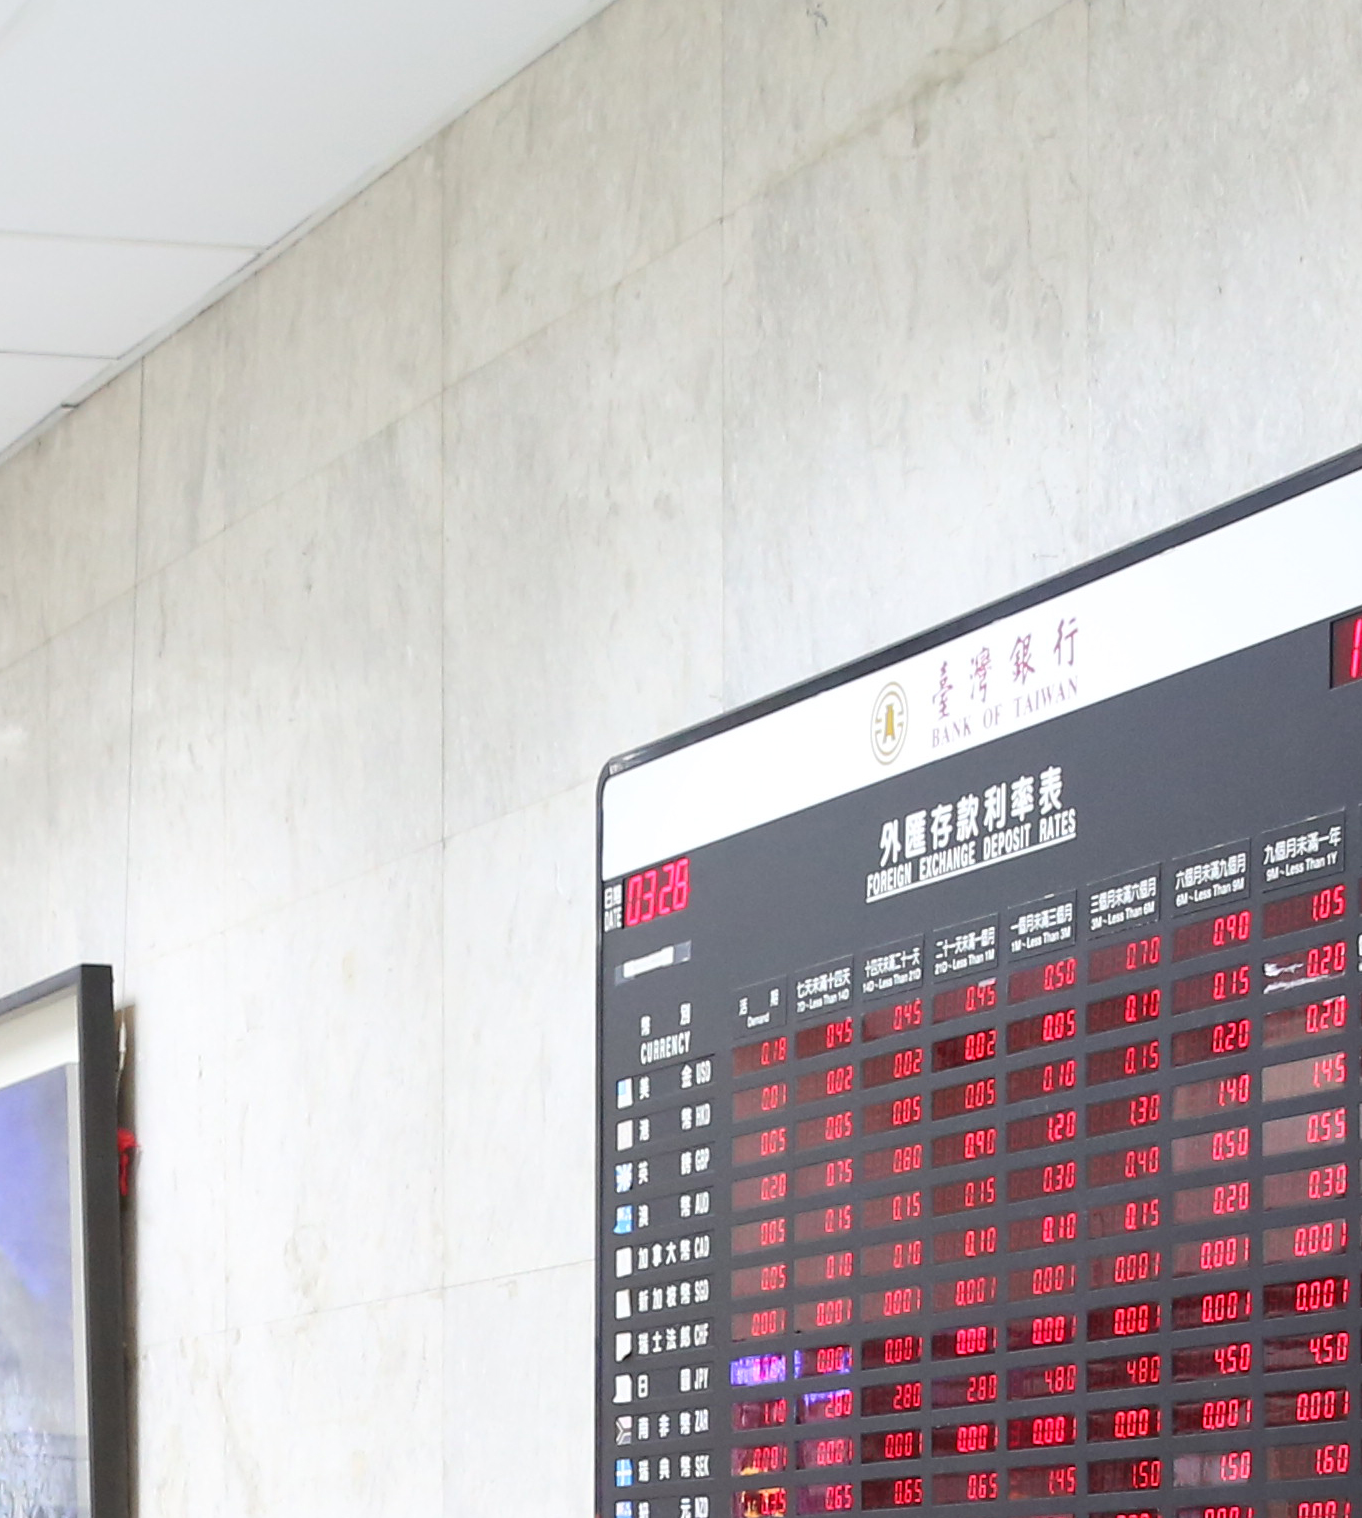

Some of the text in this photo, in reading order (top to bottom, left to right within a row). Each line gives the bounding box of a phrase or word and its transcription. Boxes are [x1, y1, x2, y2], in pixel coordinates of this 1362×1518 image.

[931, 674, 1078, 749] BANK OF TAIWAN
[932, 616, 1079, 721] 臺灣銀行
[866, 807, 1077, 898] FOREIGN EXCHANGE DEPOSIT RATES
[879, 765, 1064, 868] 外匯存款利率表
[640, 1030, 692, 1066] CURRENCY
